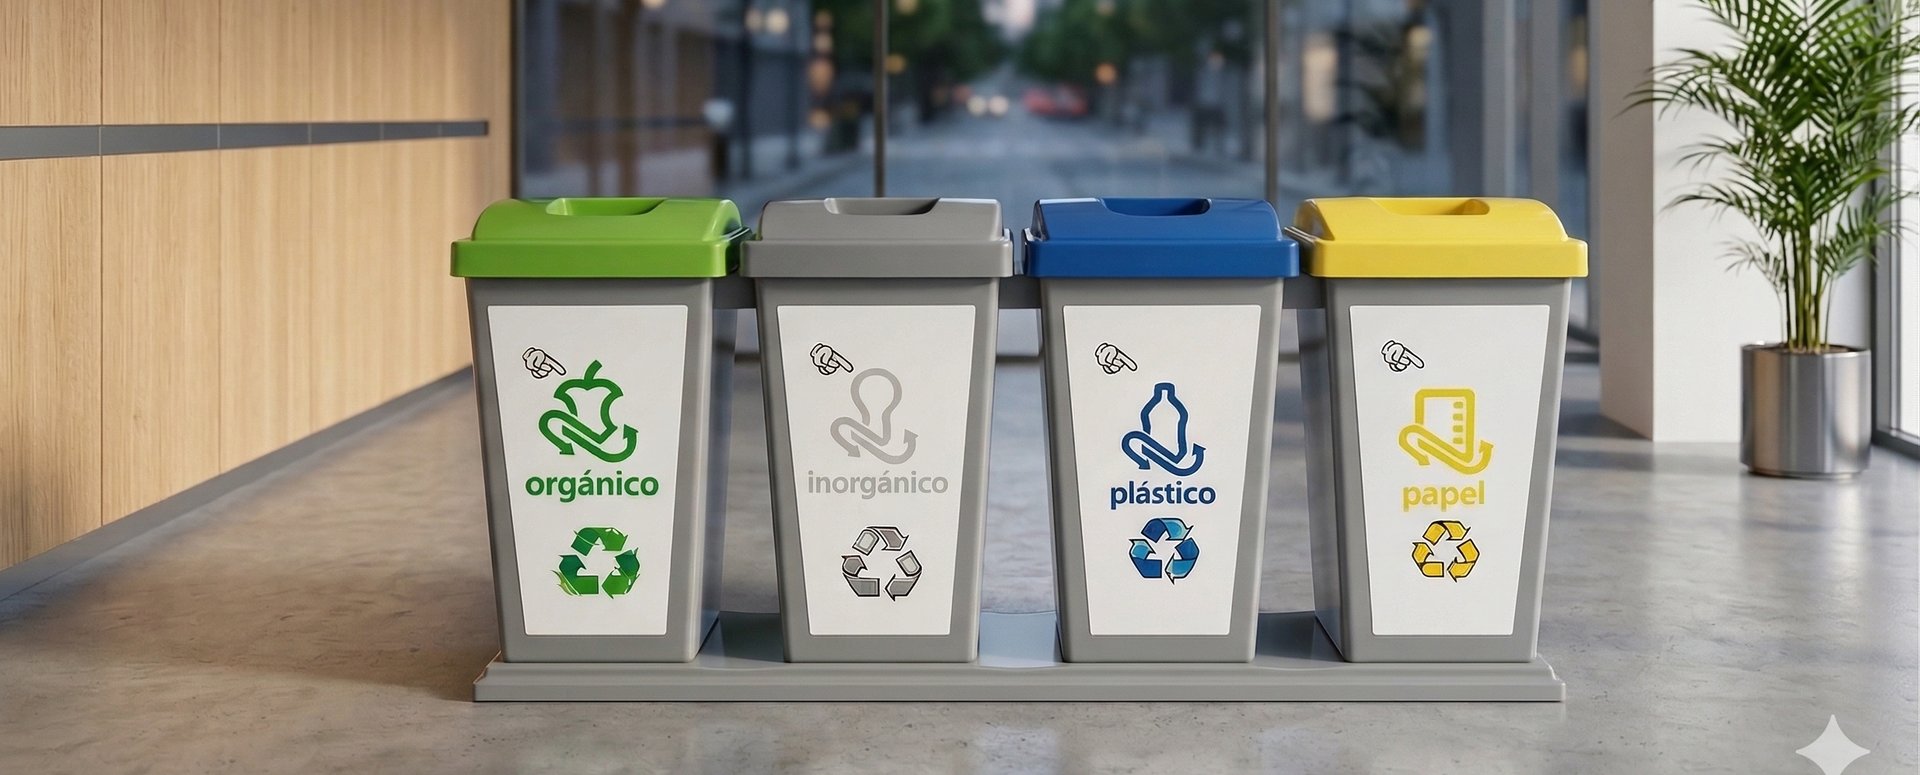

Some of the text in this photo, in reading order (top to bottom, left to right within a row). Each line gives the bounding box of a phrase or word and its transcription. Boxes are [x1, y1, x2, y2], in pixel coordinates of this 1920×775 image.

[525, 470, 659, 502] orgánico
[807, 470, 949, 500] inorgánico
[1110, 481, 1216, 510] plástico
[1402, 480, 1485, 512] papel
